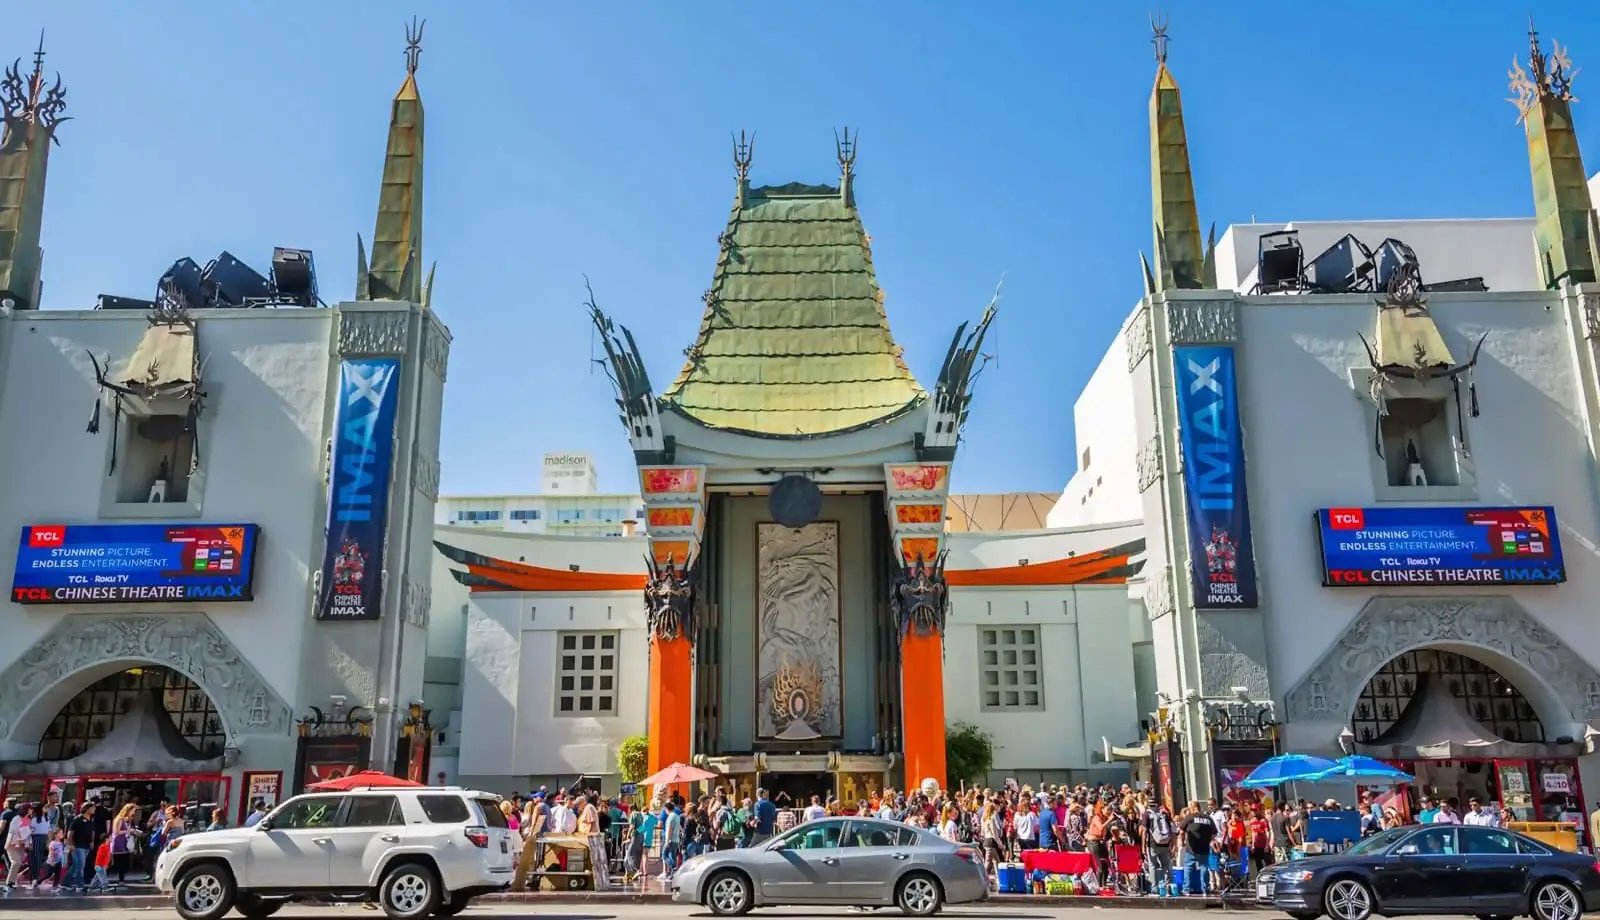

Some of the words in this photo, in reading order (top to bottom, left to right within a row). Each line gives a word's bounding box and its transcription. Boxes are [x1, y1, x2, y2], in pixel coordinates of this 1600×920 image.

[1188, 355, 1235, 511] IMAX
[337, 364, 384, 522] IMAX
[544, 454, 587, 465] madison
[1335, 514, 1360, 524] TCL
[36, 532, 60, 541] TCL
[1355, 531, 1409, 539] STUNNING
[1340, 542, 1387, 551] ENDLESS
[51, 548, 104, 557] STUNNING
[32, 559, 79, 568] ENDLESS
[1380, 558, 1401, 566] TCL
[1428, 557, 1441, 565] TV
[68, 575, 88, 583] TCL
[117, 574, 129, 583] TV
[1209, 573, 1237, 582] TCL
[1328, 569, 1369, 582] TCL
[1371, 569, 1434, 581] CHINESE
[1435, 568, 1502, 581] THEATRE
[1504, 568, 1561, 580] IMAX
[14, 588, 52, 600] TCL
[55, 587, 117, 600] CHINESE
[120, 586, 184, 599] THEATRE
[187, 586, 242, 598] IMAX
[335, 585, 361, 594] TCL
[1207, 595, 1244, 603] IMAX
[330, 606, 366, 616] IMAX
